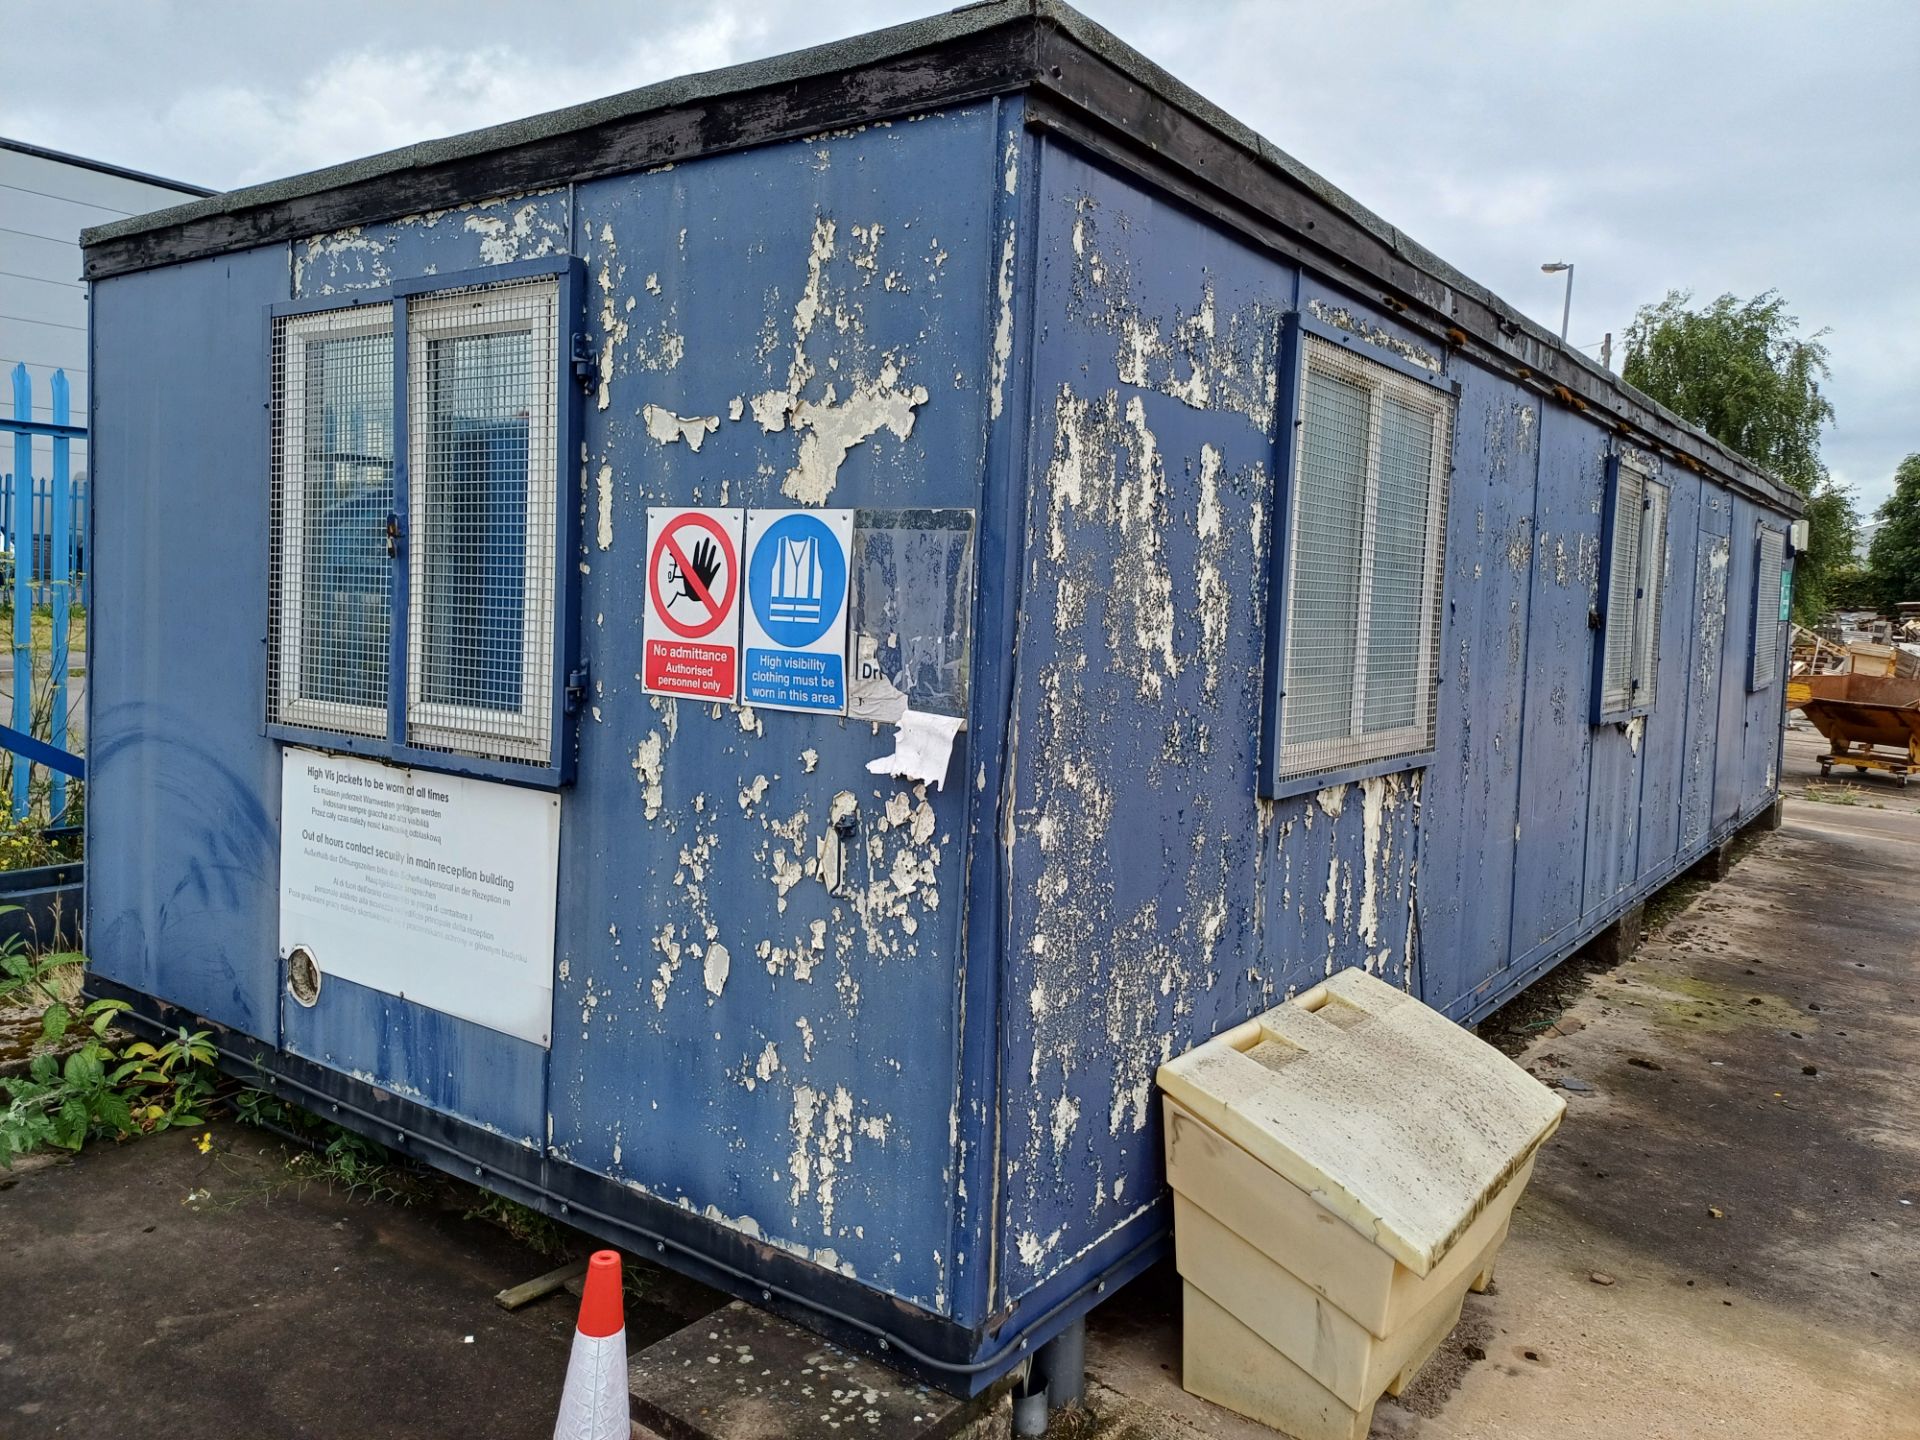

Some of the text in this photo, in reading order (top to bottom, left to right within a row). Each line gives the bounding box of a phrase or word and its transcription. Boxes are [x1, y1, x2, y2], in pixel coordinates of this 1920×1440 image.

[653, 644, 727, 662] No admittance
[665, 662, 713, 676] Authorised
[760, 655, 826, 674] High visibility
[657, 675, 721, 692] personnel only
[752, 671, 835, 688] clothing must be
[752, 687, 835, 704] worn in this area
[308, 766, 449, 802] High Vis jackets to be worn at all times
[313, 784, 320, 793] Es
[420, 808, 441, 818] werden
[301, 828, 514, 892] Out of hours contact security in main reception building
